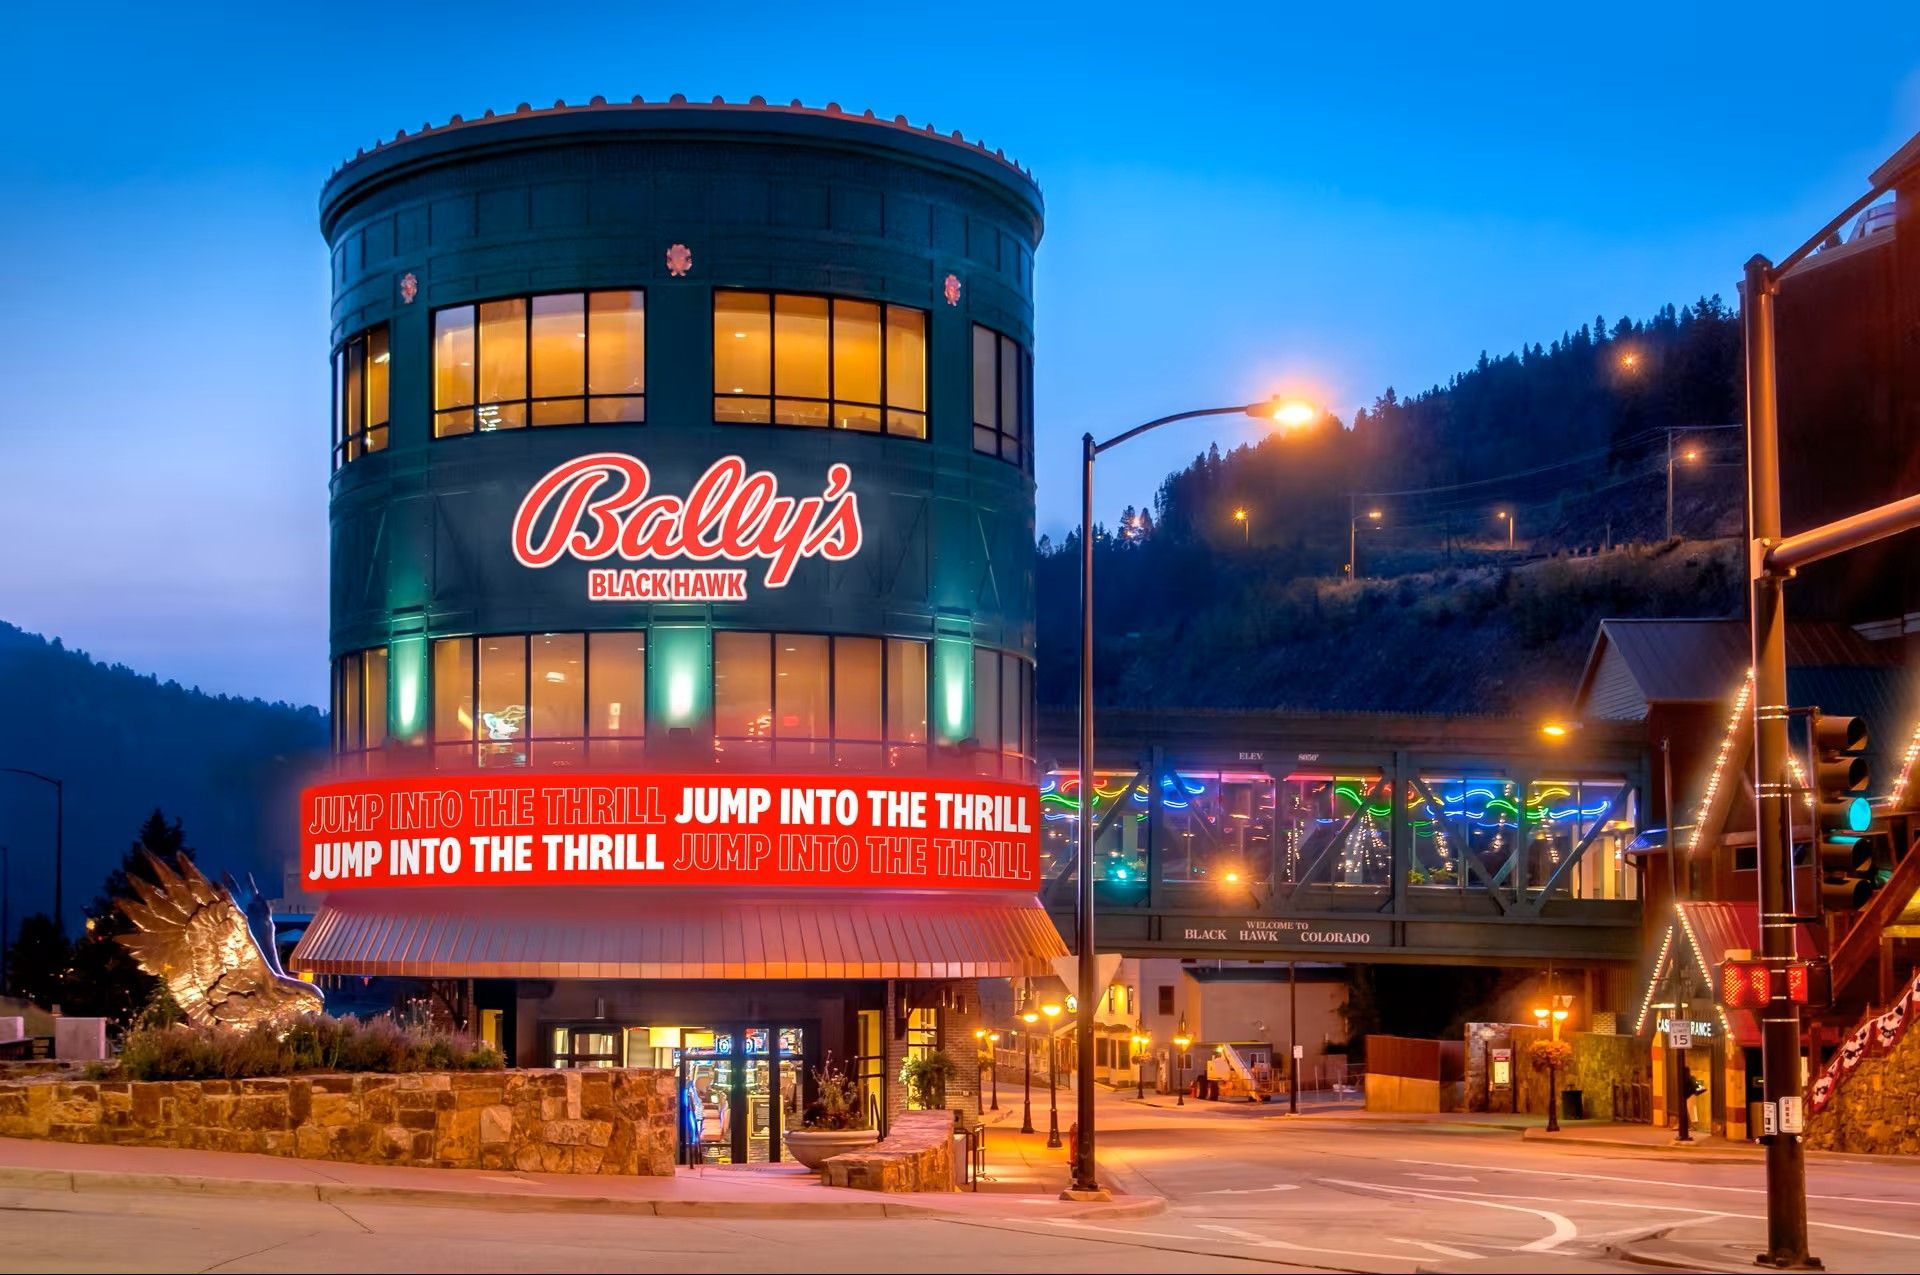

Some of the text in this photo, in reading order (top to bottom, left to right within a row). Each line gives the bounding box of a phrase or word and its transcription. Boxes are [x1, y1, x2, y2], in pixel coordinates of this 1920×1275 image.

[512, 452, 863, 588] Bally's
[591, 572, 744, 597] BLACK HAWK
[309, 787, 666, 834] JUMP INTO THE THRILL
[674, 787, 1032, 834] JUMP INTO THE THRILL
[308, 834, 665, 881] JUMP INTO THE THRILL
[673, 833, 1032, 881] JUMP INTO THE THRILL
[1184, 929, 1370, 944] BLACK HAWK COLORADO
[1246, 921, 1309, 930] WELCOME TO
[1673, 1034, 1688, 1046] 15
